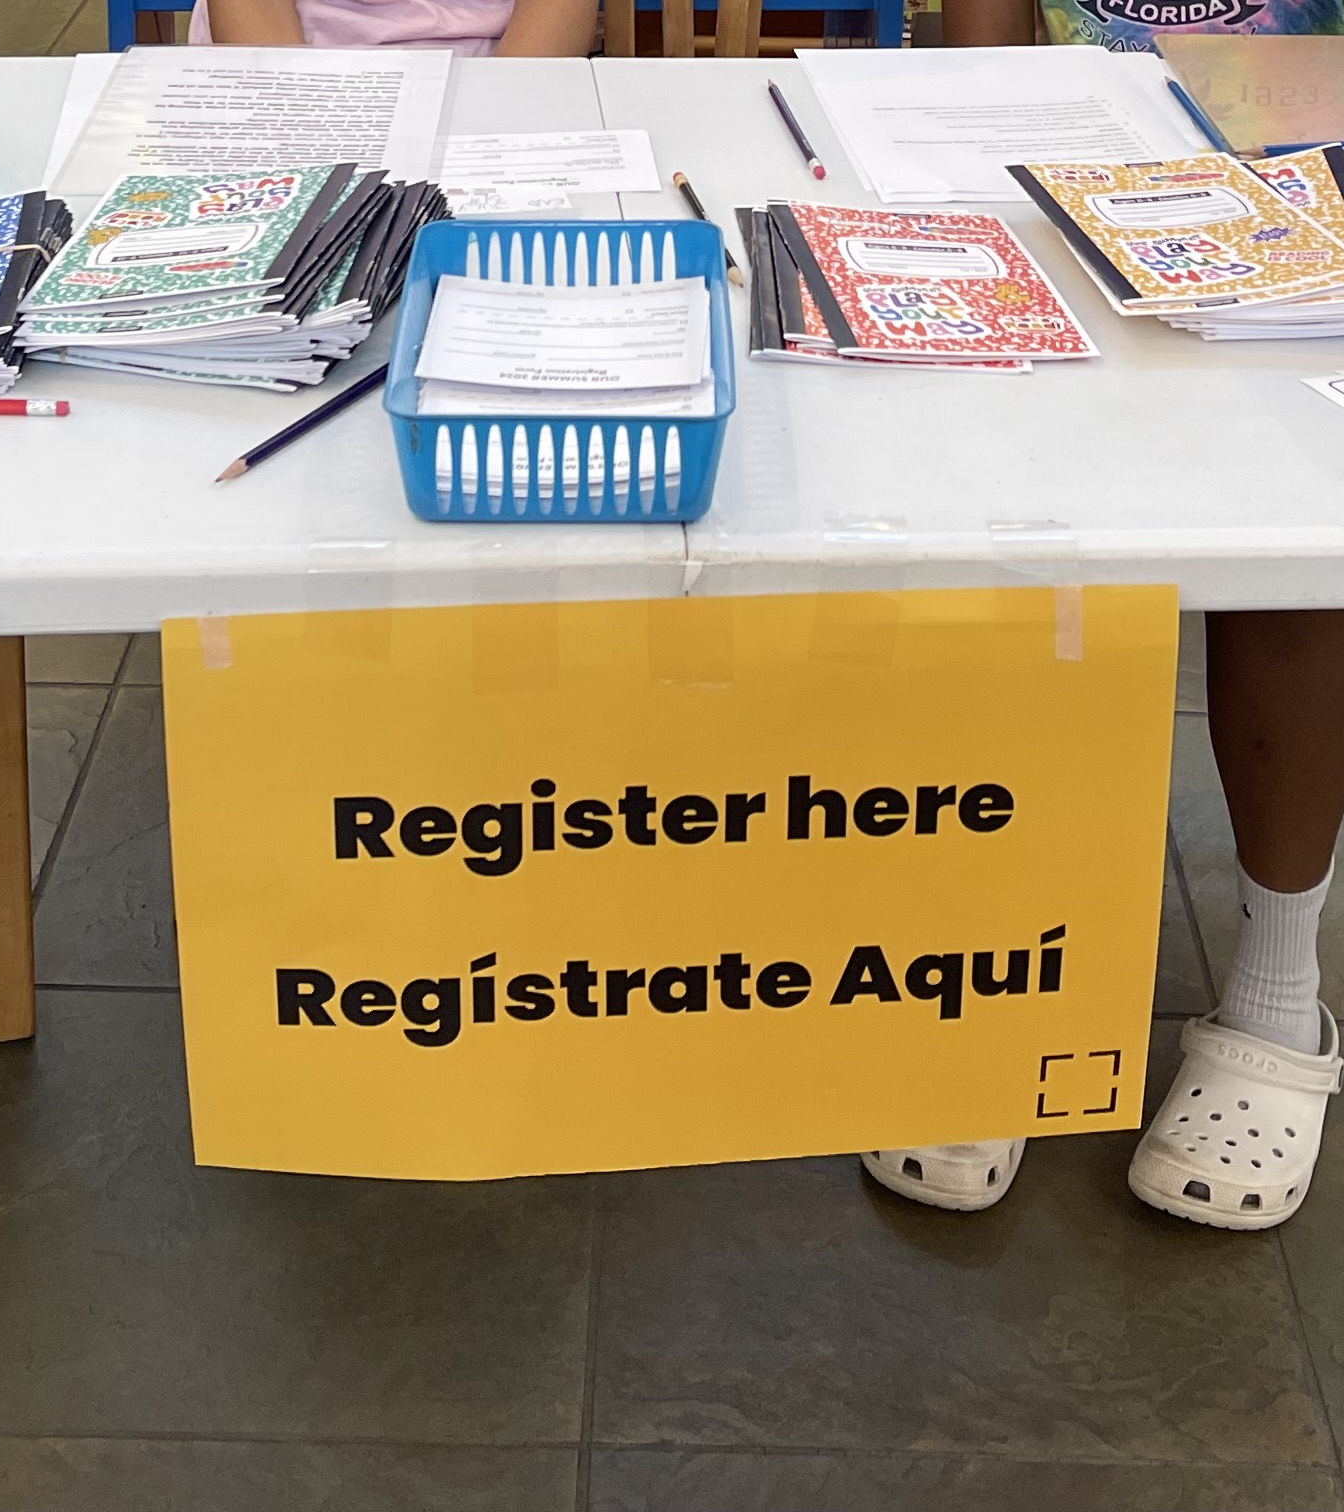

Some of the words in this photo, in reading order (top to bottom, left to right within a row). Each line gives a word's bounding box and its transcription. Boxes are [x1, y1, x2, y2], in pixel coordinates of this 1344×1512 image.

[332, 777, 767, 878] Register
[785, 773, 1016, 843] here
[274, 950, 814, 1049] Regístrate
[829, 923, 1069, 1021] Aquí
